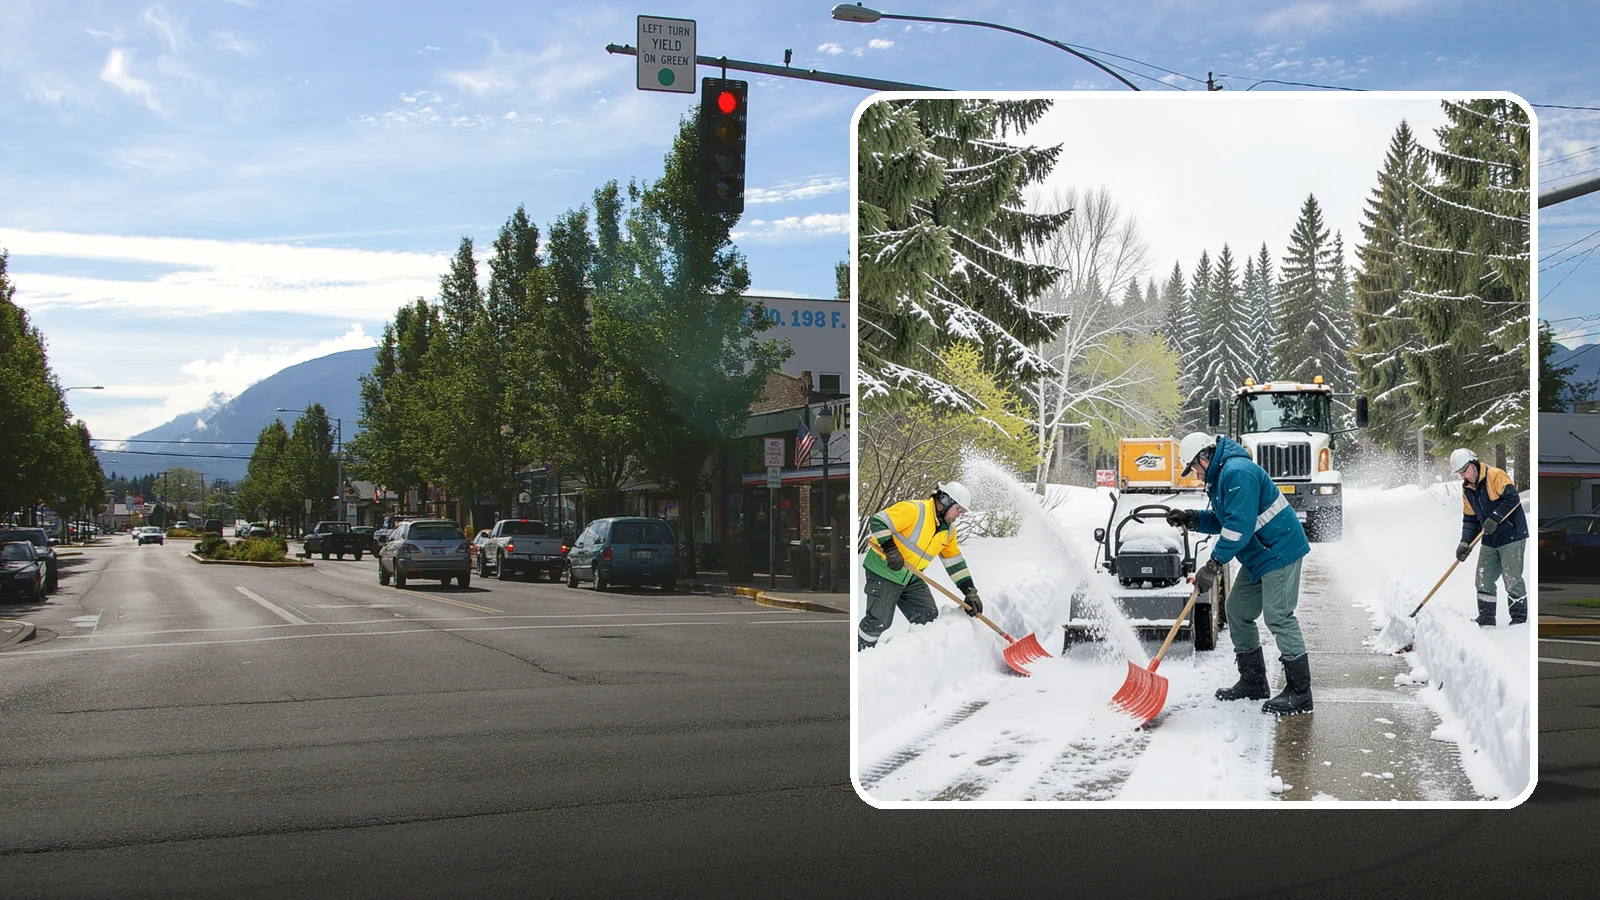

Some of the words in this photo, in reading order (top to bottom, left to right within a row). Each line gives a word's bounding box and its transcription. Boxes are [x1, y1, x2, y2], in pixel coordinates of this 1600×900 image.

[643, 24, 663, 34] LEFT
[668, 26, 690, 36] TURN
[652, 38, 682, 51] YIELD
[644, 53, 656, 64] ON
[661, 55, 689, 66] GREEN
[791, 309, 826, 328] 198
[831, 311, 846, 329] F.
